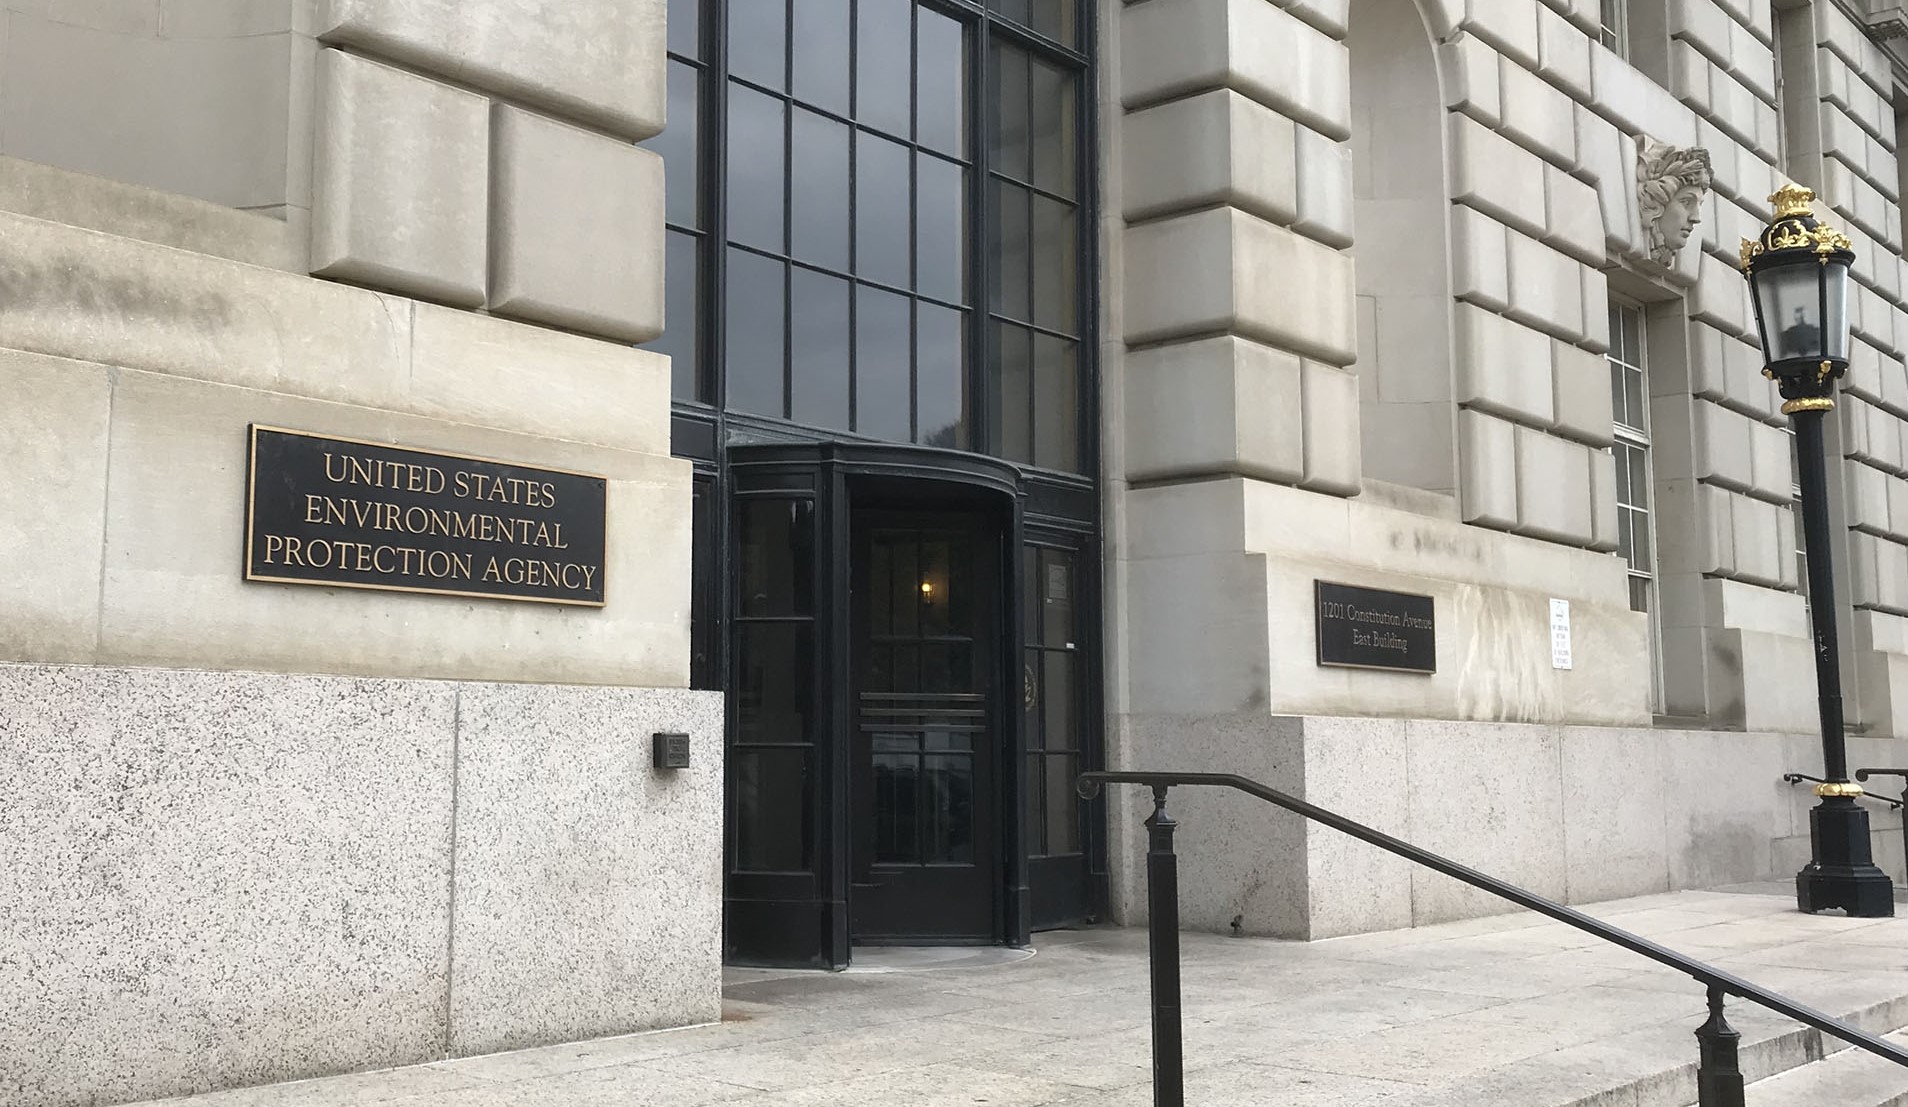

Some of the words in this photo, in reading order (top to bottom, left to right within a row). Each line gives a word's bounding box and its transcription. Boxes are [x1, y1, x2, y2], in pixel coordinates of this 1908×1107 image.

[323, 452, 446, 495] UNITED
[453, 471, 556, 508] STATES
[304, 494, 569, 549] ENVIRONMENTAL
[263, 534, 473, 580] PROTECTION
[481, 556, 597, 591] AGENCY
[1323, 602, 1344, 619] 1201
[1347, 604, 1401, 626] Constitution
[1402, 611, 1433, 629] Avenue
[1352, 629, 1371, 646] East
[1372, 631, 1408, 653] Building
